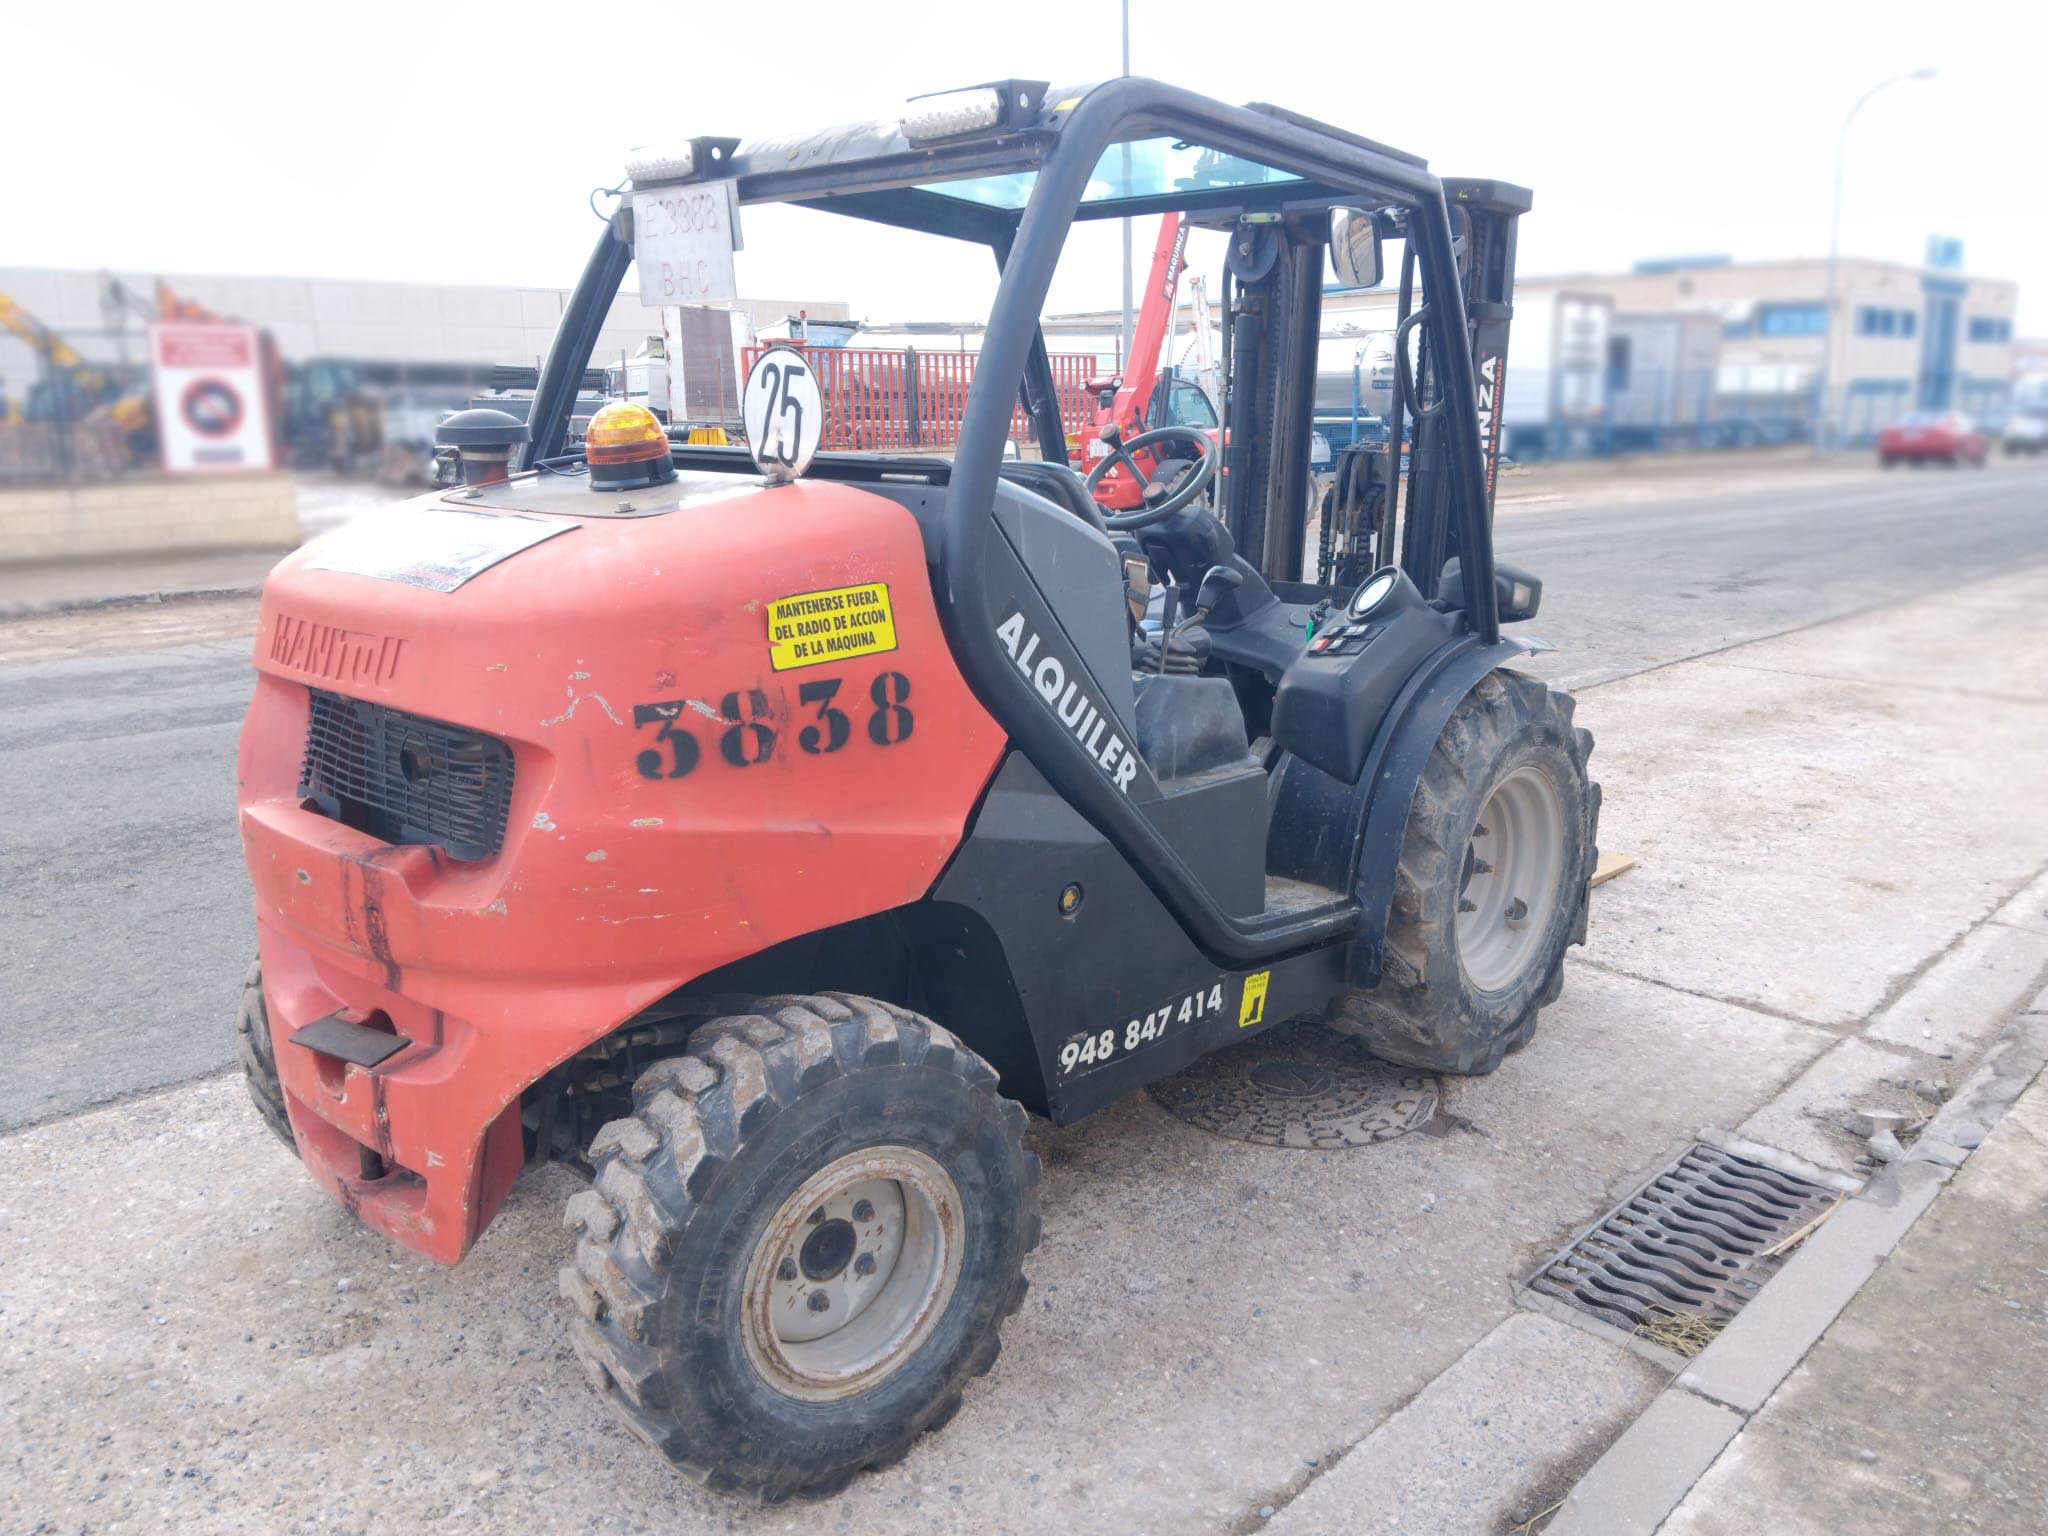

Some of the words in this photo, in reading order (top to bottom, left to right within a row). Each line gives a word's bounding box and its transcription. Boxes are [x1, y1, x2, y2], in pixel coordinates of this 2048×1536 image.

[1167, 226, 1186, 281] MAQUINZA
[758, 362, 806, 468] 25
[1490, 439, 1497, 453] DE
[774, 624, 795, 640] DEL
[797, 618, 831, 637] RADIO
[833, 615, 848, 631] DE
[850, 605, 887, 627] ACCIÓN
[776, 594, 845, 620] MANTENERSE
[846, 590, 880, 608] FUERA
[793, 642, 809, 658] DE
[810, 640, 825, 655] LA
[826, 631, 876, 654] MÁQUINA
[634, 671, 915, 781] 3838
[996, 612, 1137, 795] ALQUILER
[1060, 1029, 1115, 1074] 948
[1124, 1004, 1173, 1050] 847
[1177, 983, 1223, 1024] 414
